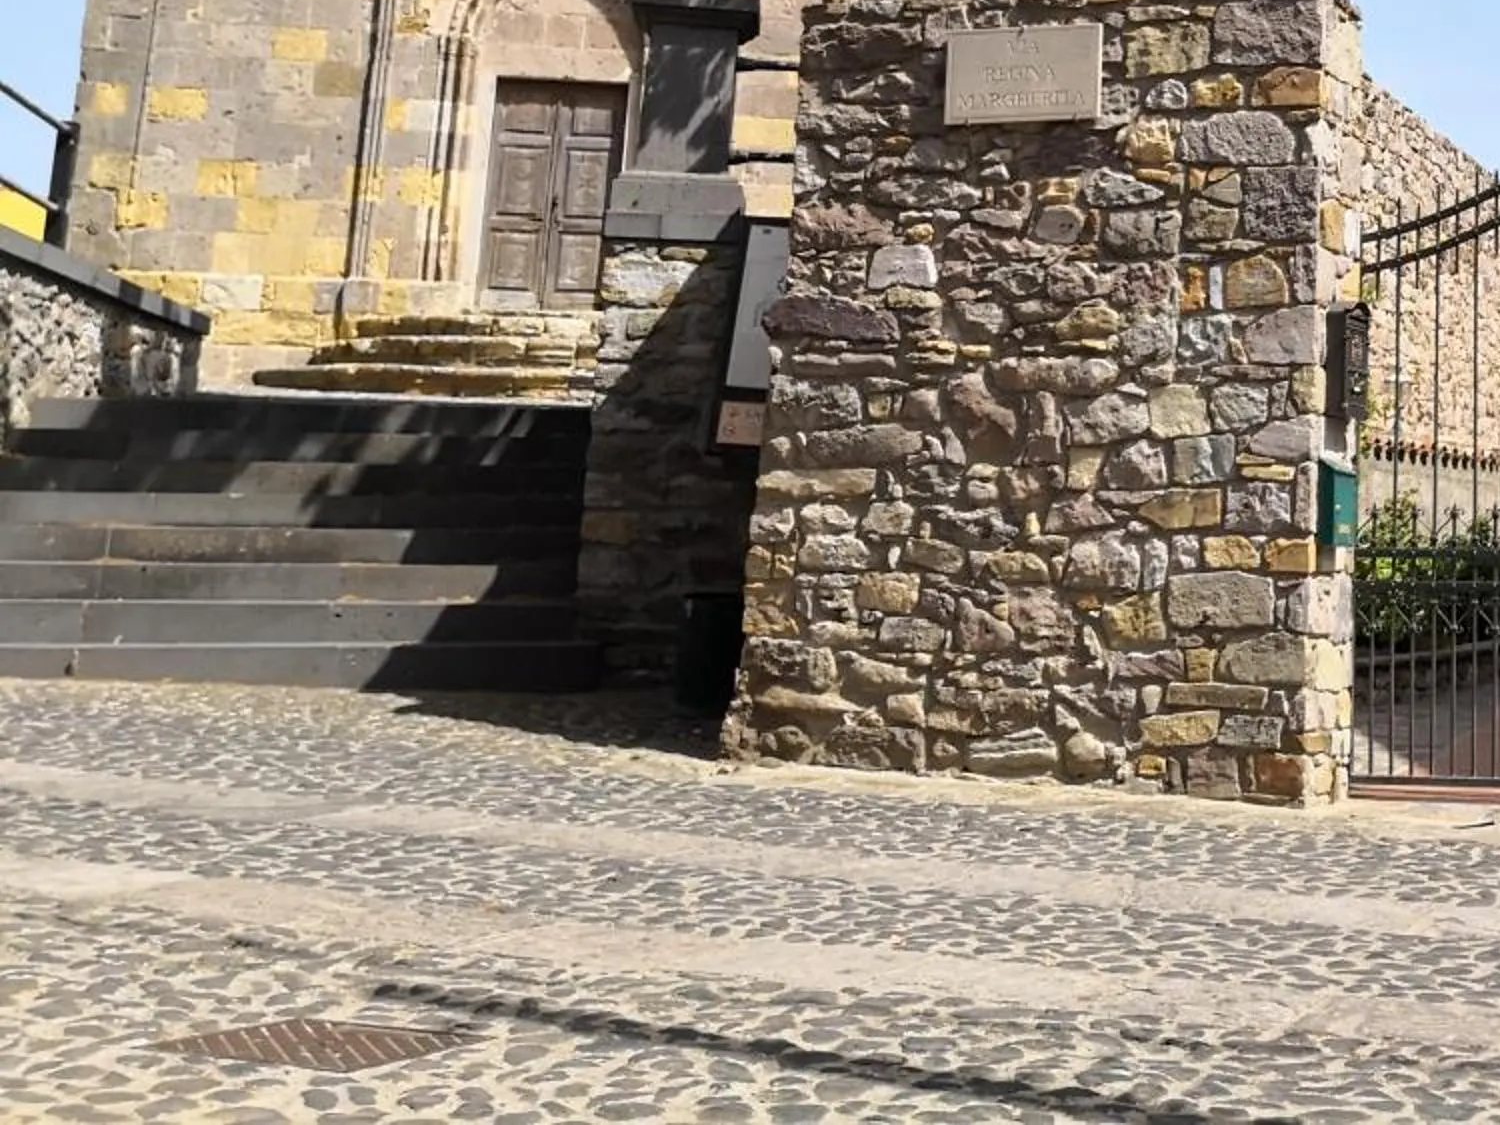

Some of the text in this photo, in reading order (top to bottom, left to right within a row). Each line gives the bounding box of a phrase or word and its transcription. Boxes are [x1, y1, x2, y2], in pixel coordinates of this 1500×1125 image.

[1007, 39, 1040, 54] VIA
[983, 62, 1056, 83] REGINA
[957, 89, 1086, 110] MARGHERITA
